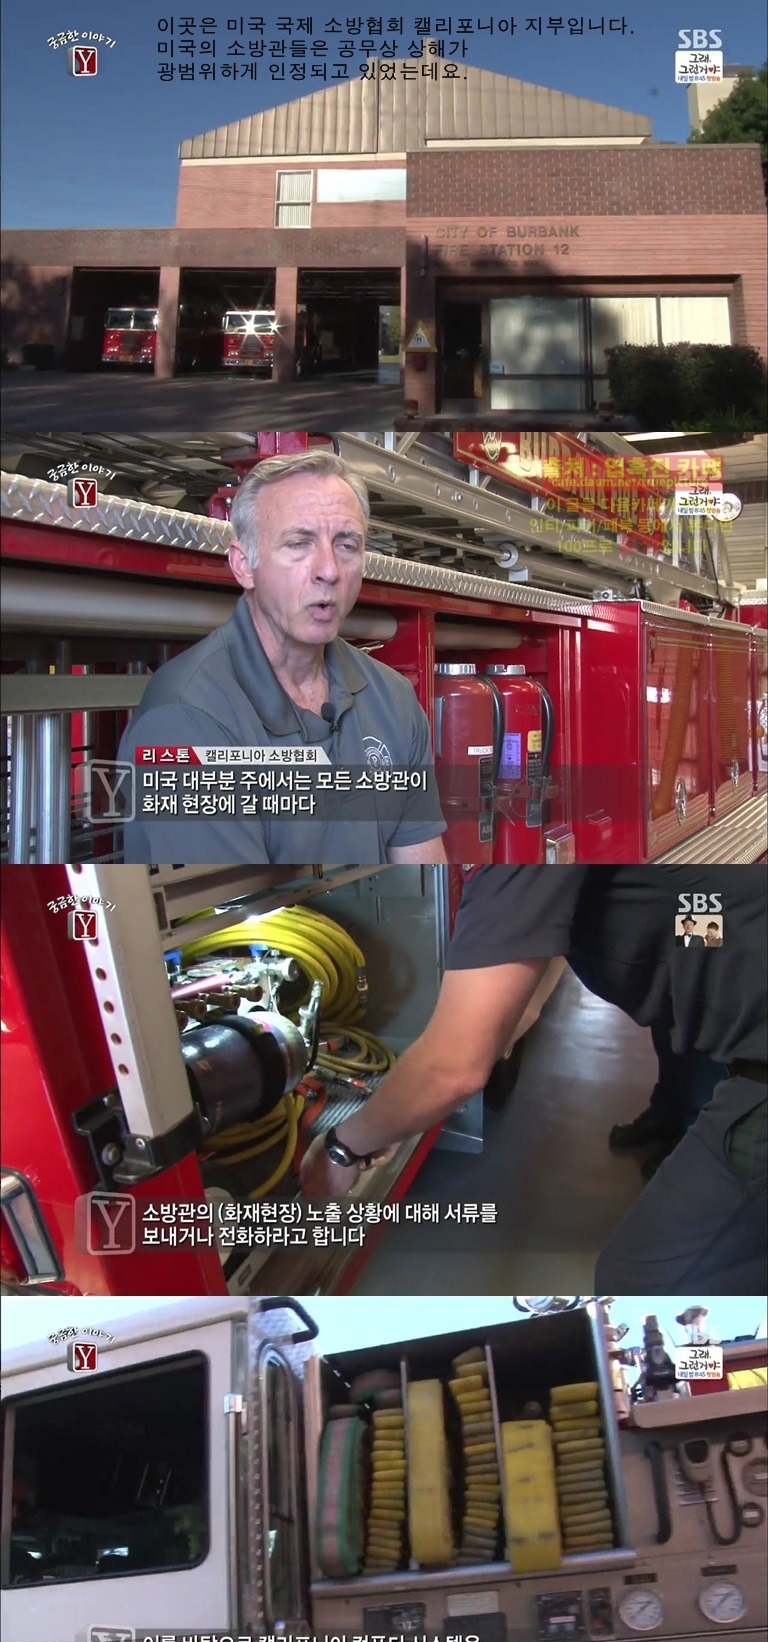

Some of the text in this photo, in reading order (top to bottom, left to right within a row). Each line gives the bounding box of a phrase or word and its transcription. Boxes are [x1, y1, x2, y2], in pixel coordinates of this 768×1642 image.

[435, 226, 580, 239] CITY OF BURBANK
[436, 243, 570, 257] FIRE STATION 12
